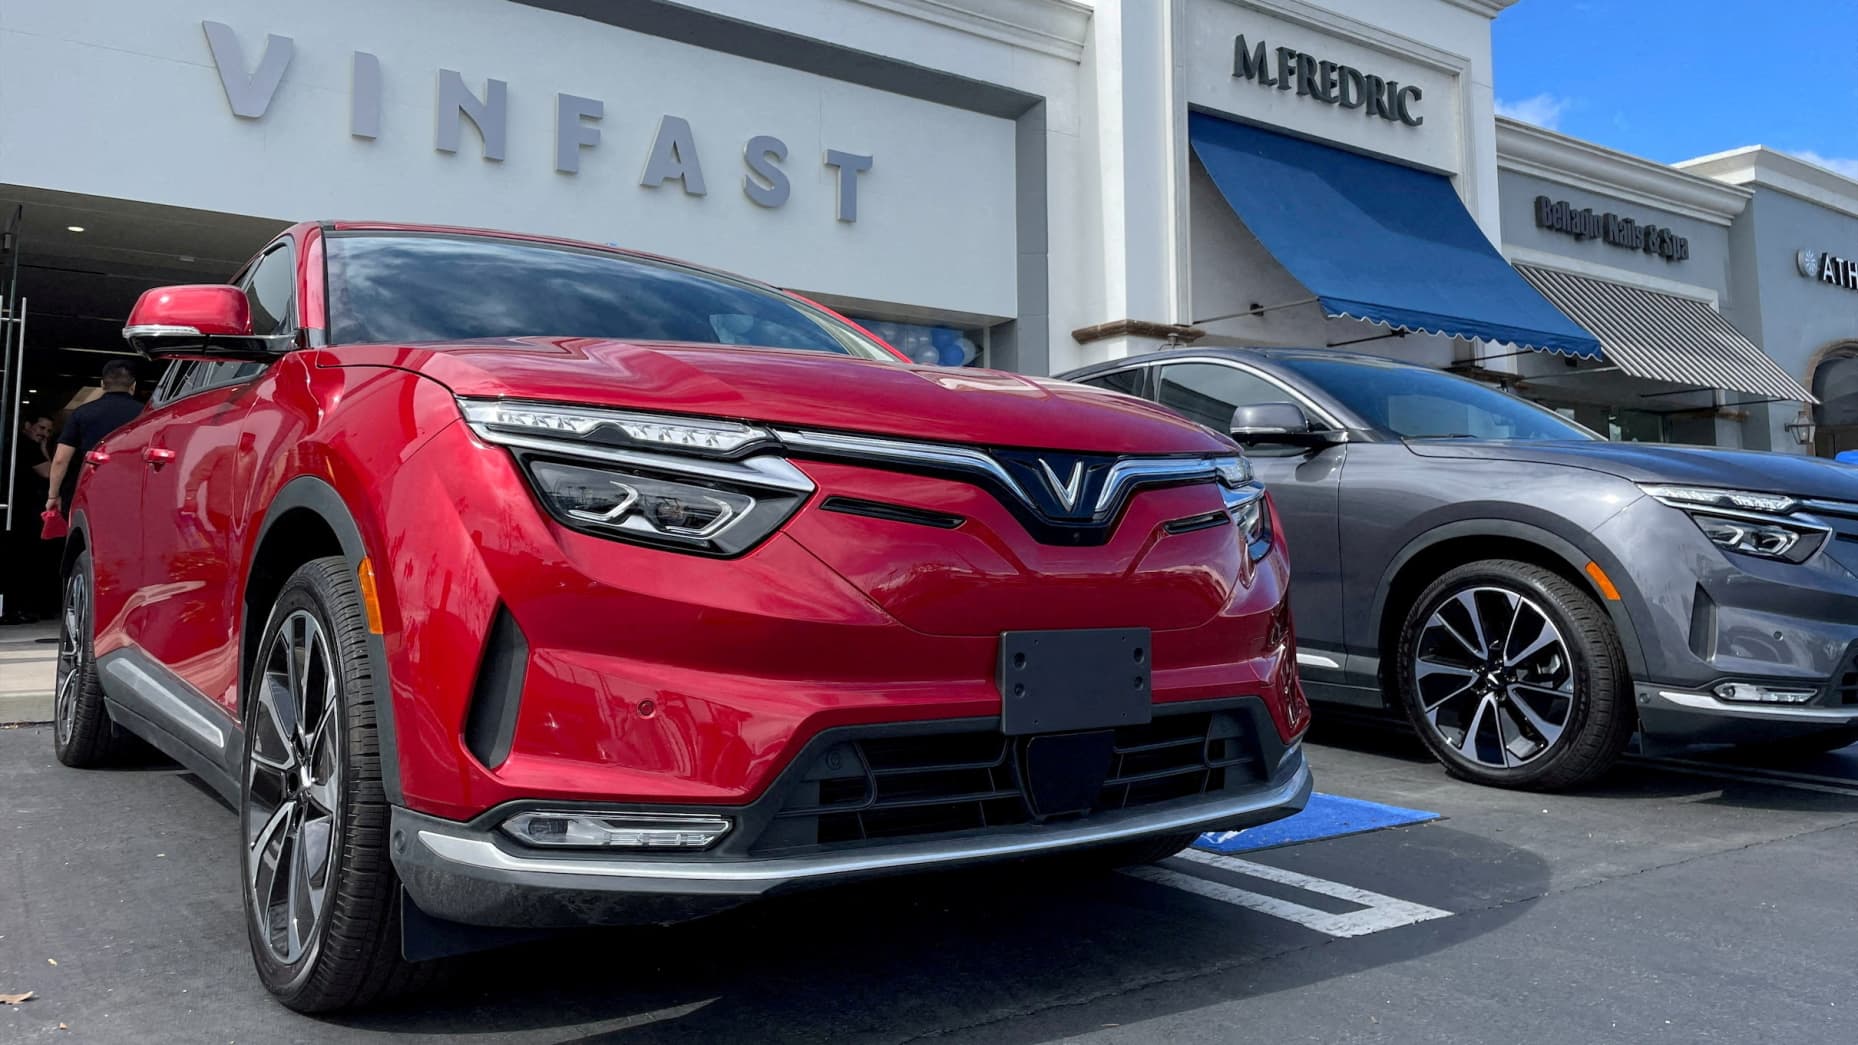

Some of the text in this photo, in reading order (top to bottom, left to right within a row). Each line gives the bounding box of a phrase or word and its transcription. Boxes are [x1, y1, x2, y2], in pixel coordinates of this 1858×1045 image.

[202, 20, 874, 223] VINFAST
[1536, 195, 1690, 263] Bellagio Nails & Spa
[1820, 252, 1858, 290] ATH
